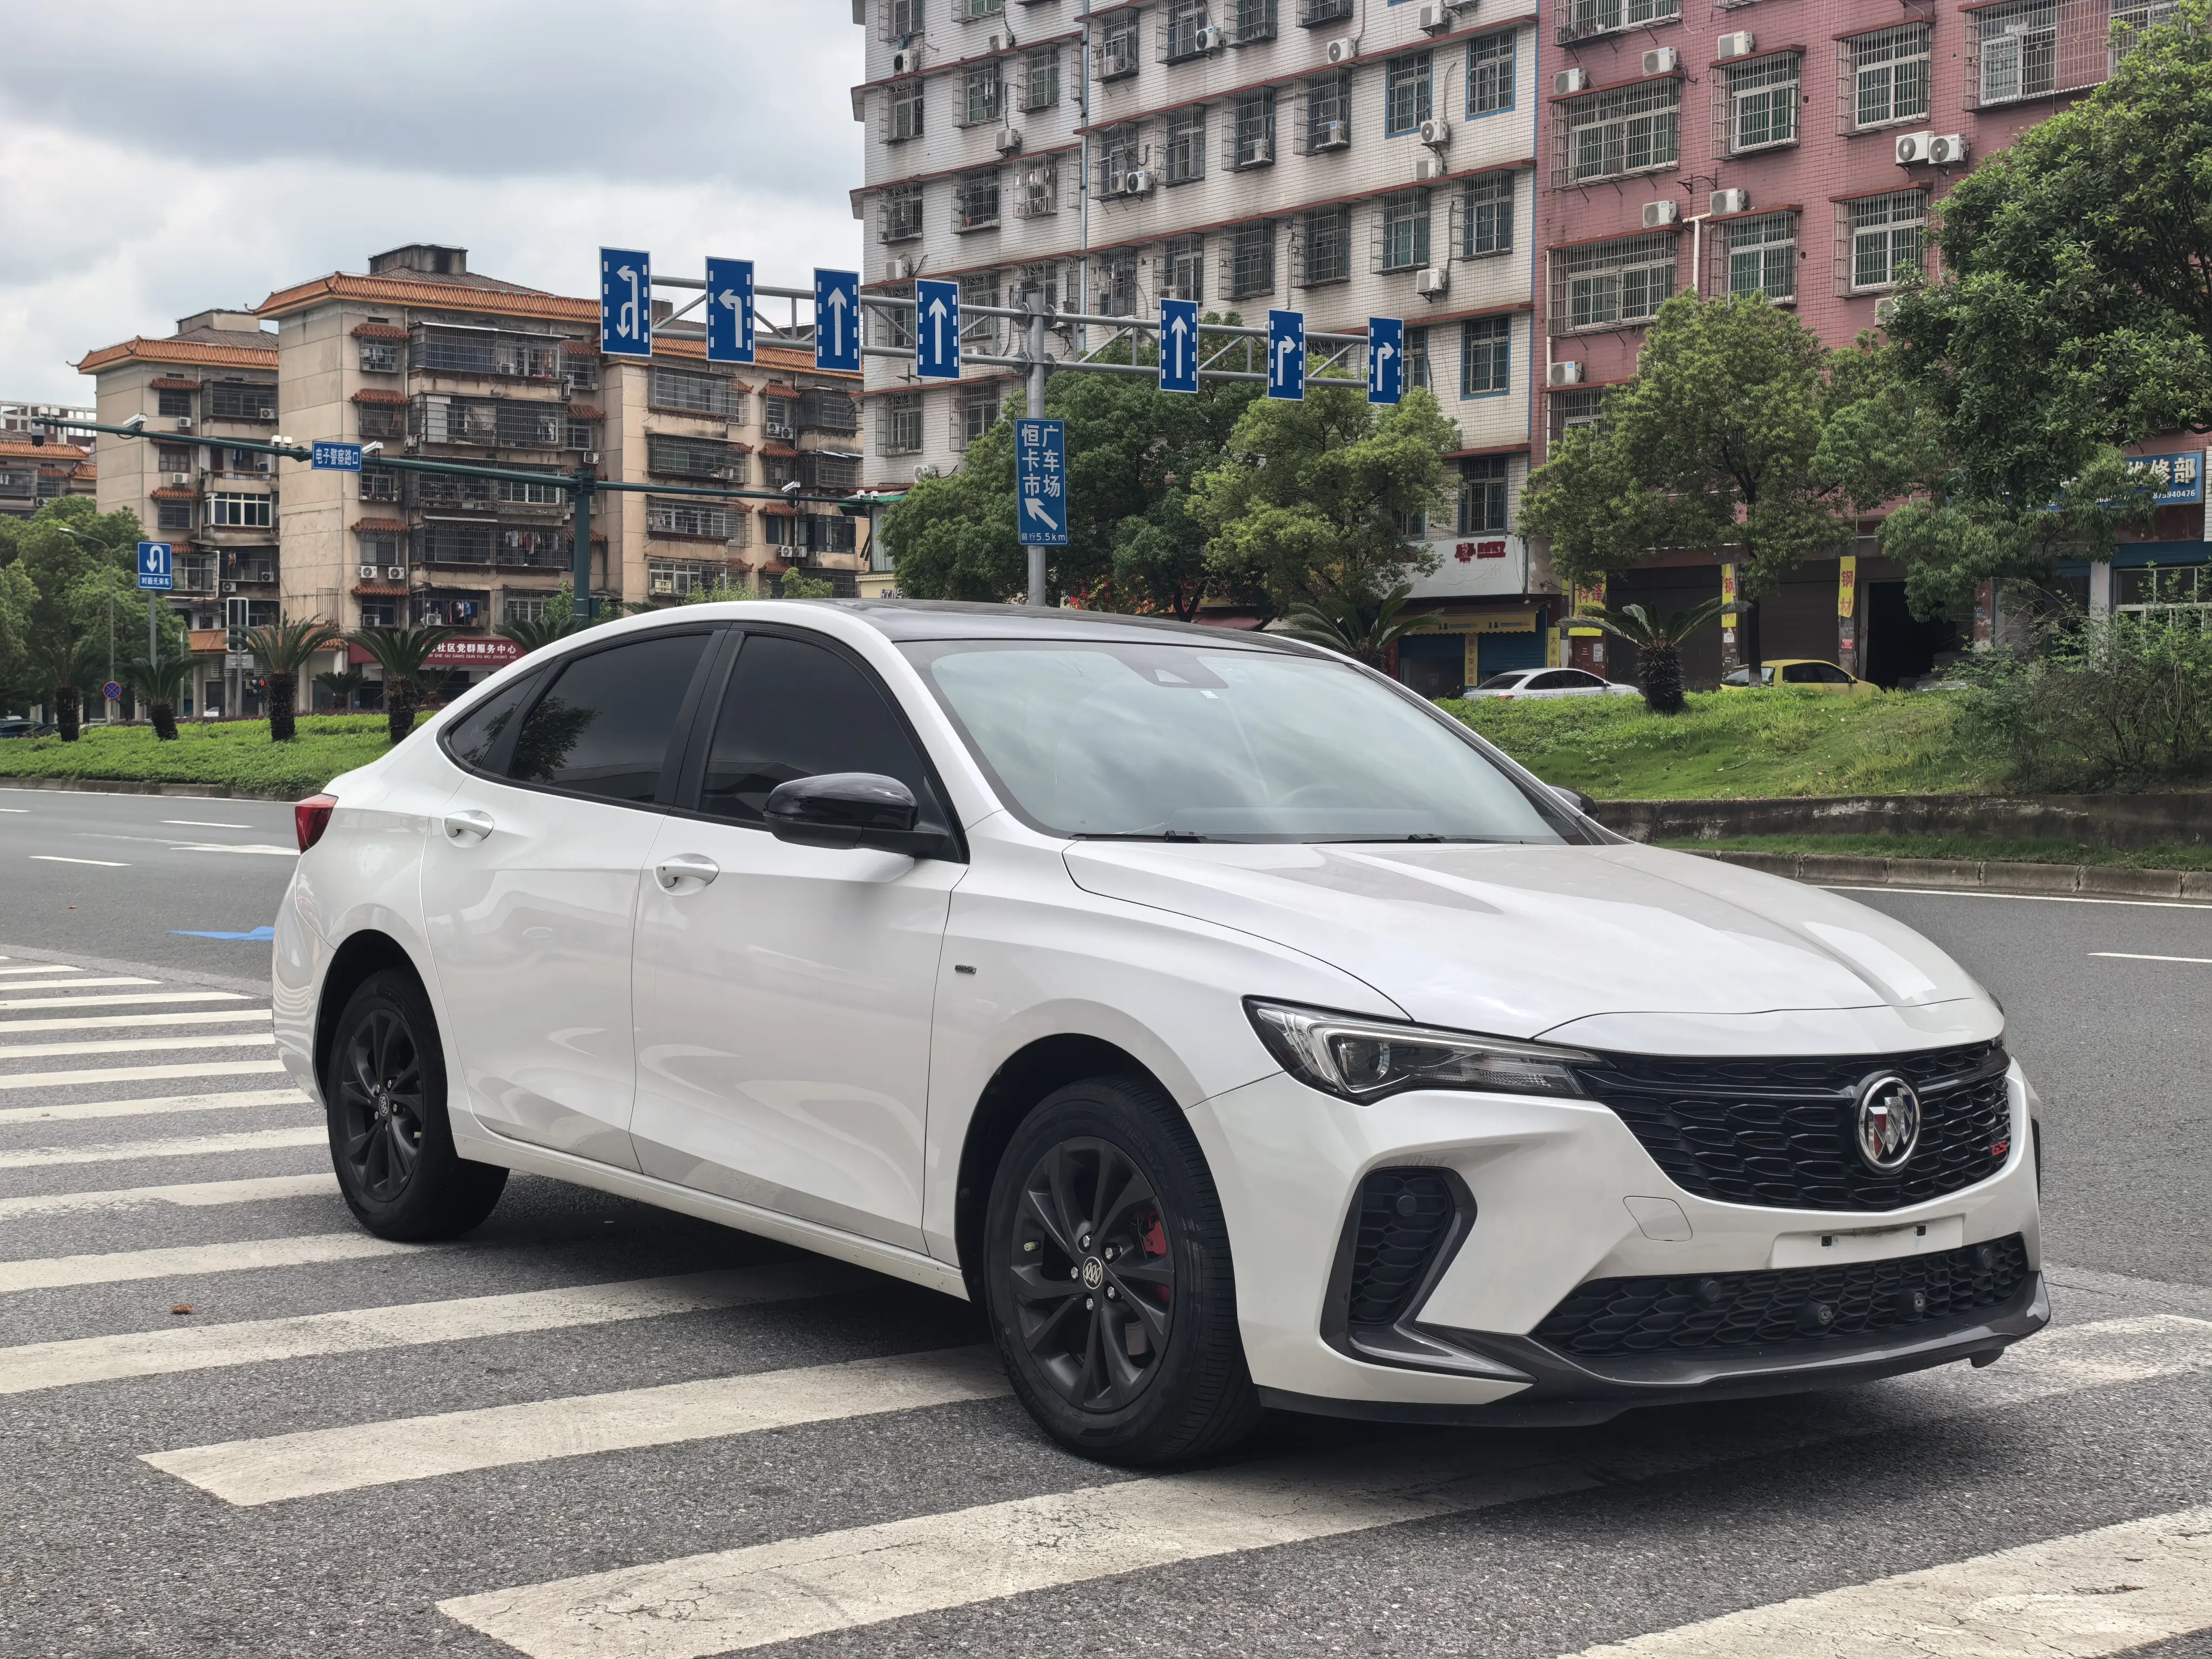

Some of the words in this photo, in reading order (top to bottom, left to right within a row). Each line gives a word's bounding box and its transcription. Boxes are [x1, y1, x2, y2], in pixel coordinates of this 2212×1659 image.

[315, 447, 359, 466] 电子警察路口
[421, 643, 516, 654] 社区党群服务中心
